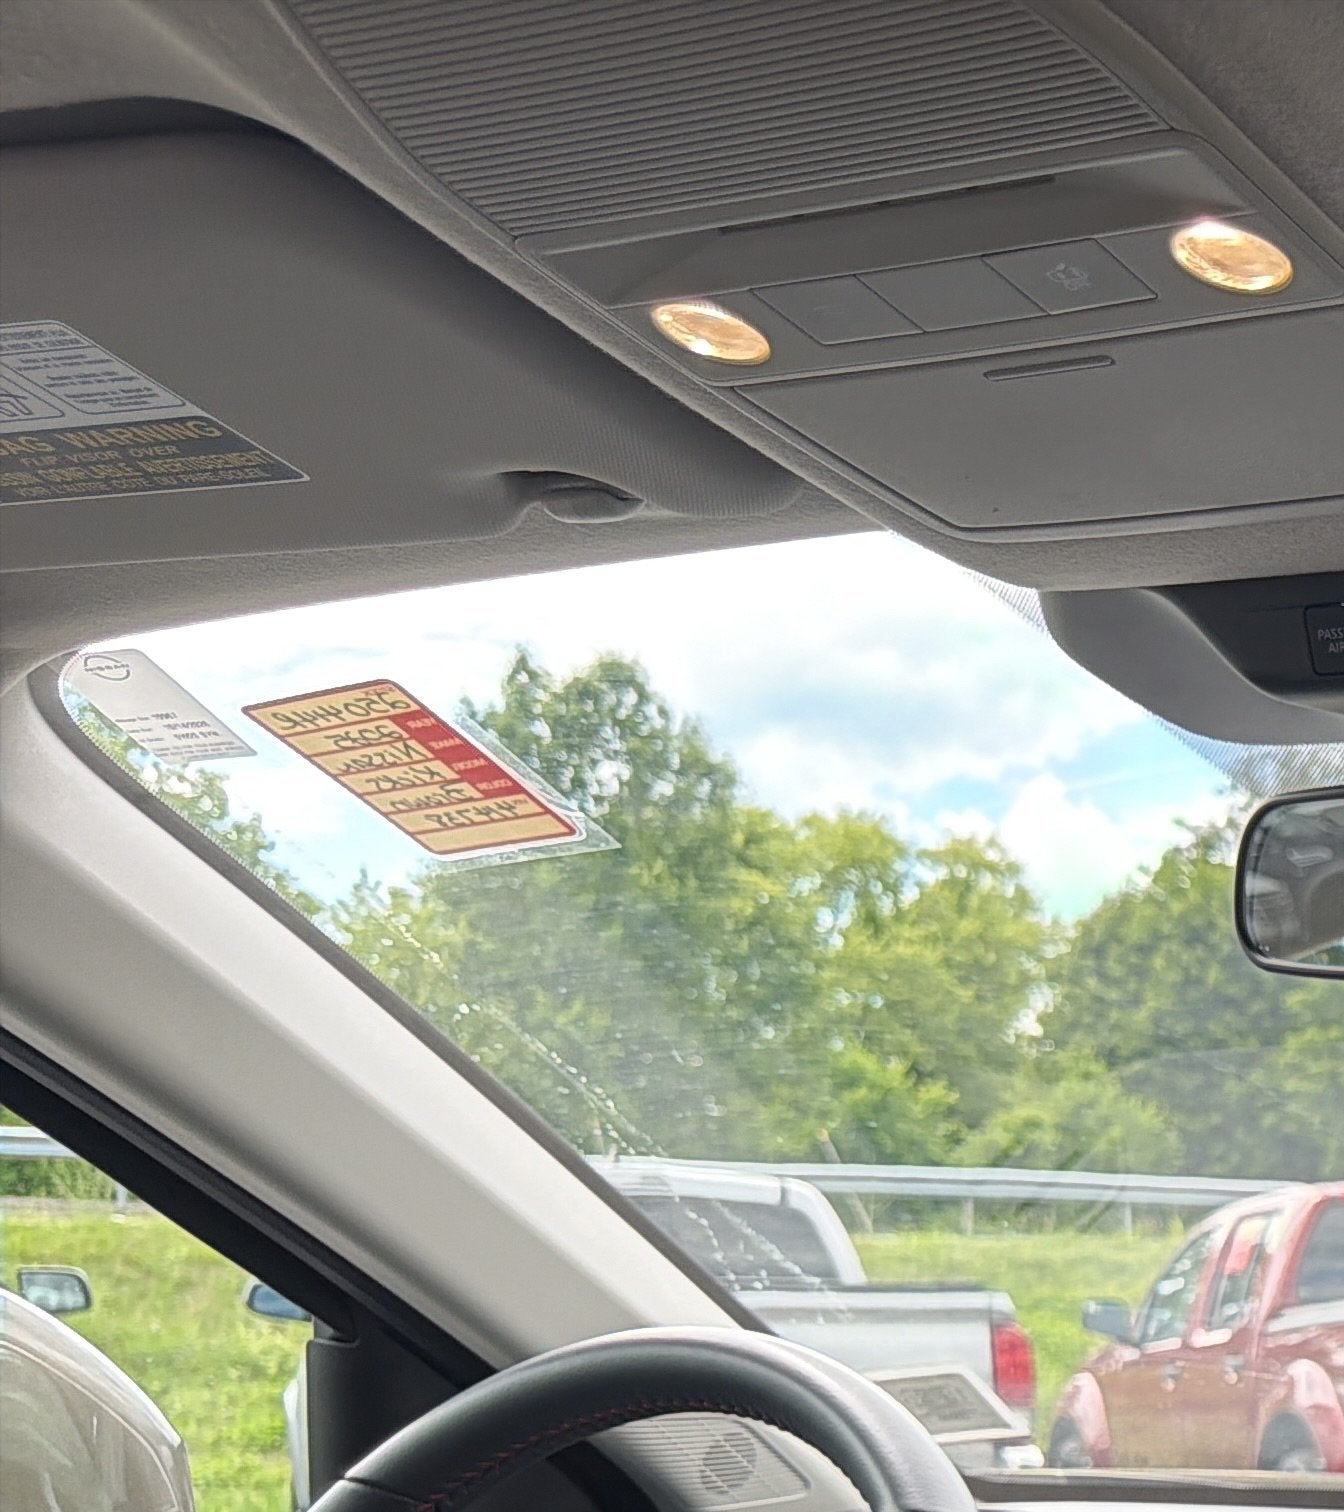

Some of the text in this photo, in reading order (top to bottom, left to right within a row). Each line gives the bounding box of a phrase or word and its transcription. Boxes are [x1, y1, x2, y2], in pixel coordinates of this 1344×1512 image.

[54, 421, 223, 449] WARNING
[20, 445, 180, 468] FLIP VISOR OVER
